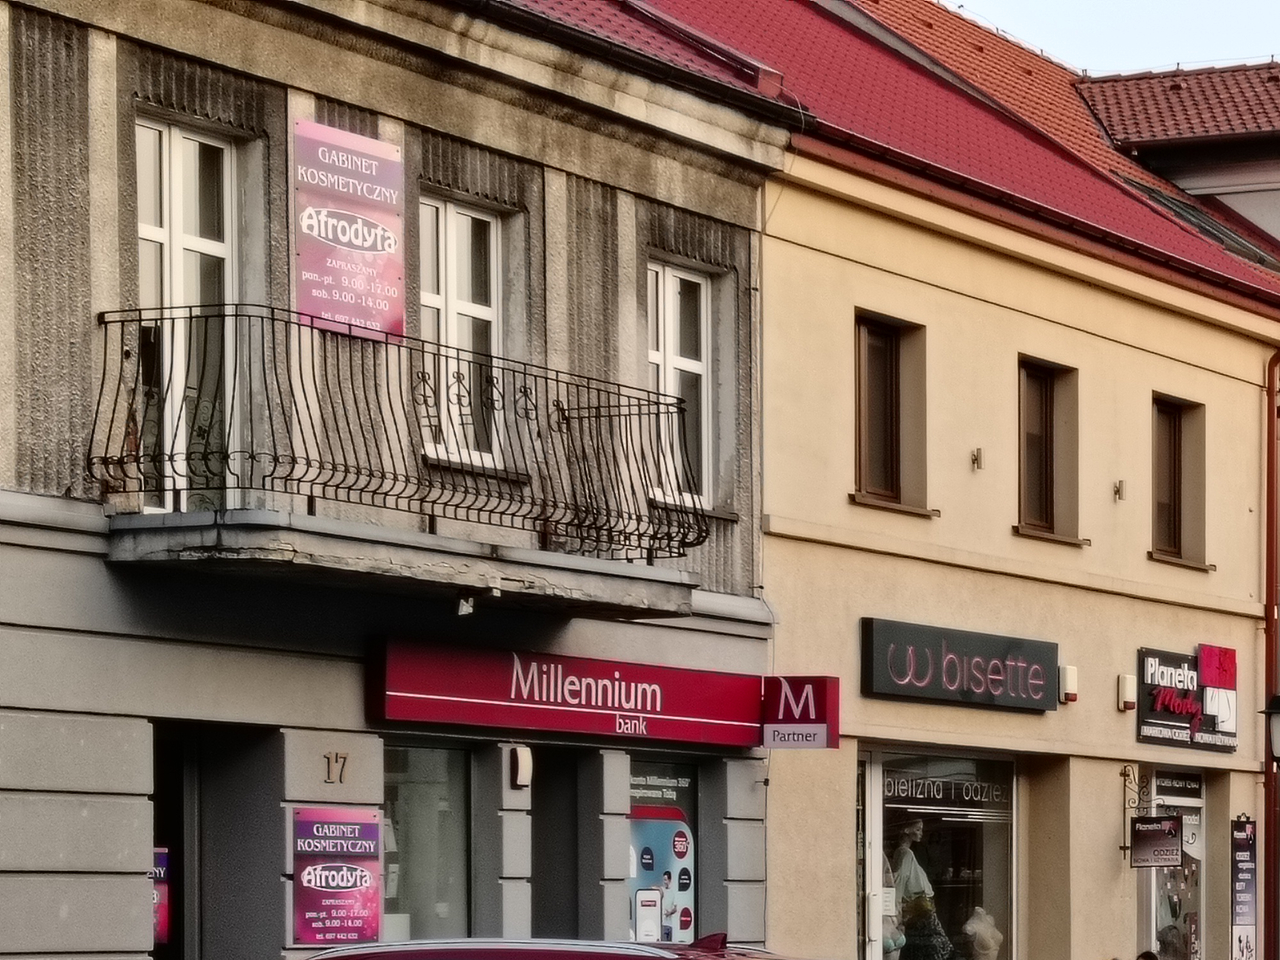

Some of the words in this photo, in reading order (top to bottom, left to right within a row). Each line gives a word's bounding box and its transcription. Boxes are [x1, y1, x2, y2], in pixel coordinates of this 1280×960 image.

[318, 147, 378, 176] GABINET
[297, 165, 399, 205] KOSMETYCZNY
[301, 206, 396, 254] Afrodyta
[326, 258, 378, 277] ZAPRASZAMY
[311, 289, 331, 299] sob.
[332, 289, 355, 304] 9.00
[341, 276, 364, 290] 9.00
[510, 651, 662, 712] Millennium
[942, 638, 1044, 699] bisette
[1144, 657, 1197, 691] Planeta
[777, 676, 817, 720] M
[1150, 687, 1203, 738] Mody
[615, 714, 648, 736] bank
[772, 730, 818, 743] Partner
[323, 751, 349, 784] 17
[884, 770, 943, 799] bielizna
[313, 823, 360, 837] GABINET
[297, 838, 376, 853] KOSMETYCZNY
[303, 864, 371, 888] Afrodyta
